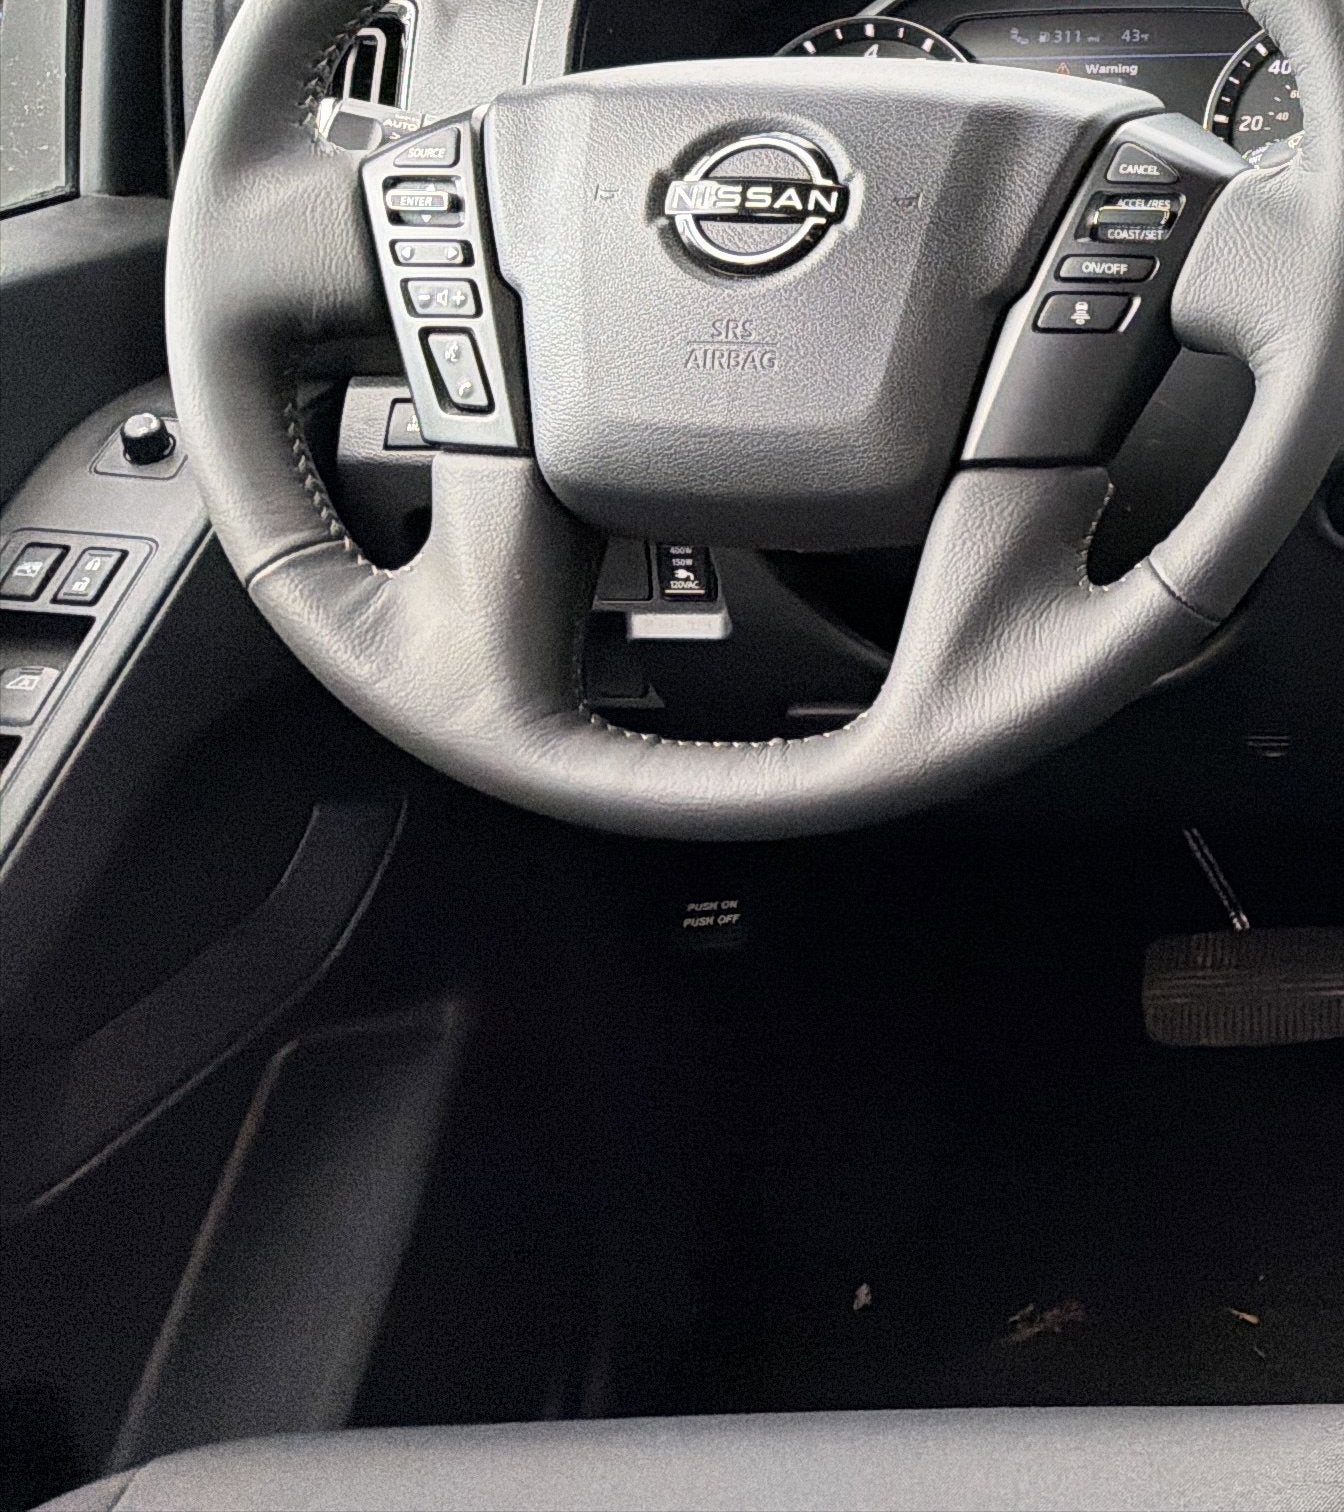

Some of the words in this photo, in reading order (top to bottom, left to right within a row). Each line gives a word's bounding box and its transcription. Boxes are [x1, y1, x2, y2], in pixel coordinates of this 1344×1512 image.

[1054, 29, 1081, 43] 311
[864, 43, 880, 58] 4
[1085, 63, 1138, 76] Warning
[1268, 59, 1292, 75] 40
[383, 118, 419, 131] AUTO
[1239, 115, 1264, 132] 20
[408, 148, 446, 159] SOURCE
[1119, 163, 1160, 176] CANCEL
[400, 196, 433, 207] ENTER
[672, 184, 839, 213] NISSAN
[1117, 198, 1171, 210] ACCEL/RES
[1107, 228, 1165, 241] COAST/SET
[1082, 261, 1128, 275] ON/OFF
[710, 318, 755, 340] SRS
[684, 347, 779, 371] AIRBAG
[686, 901, 720, 912] PUSH
[721, 899, 739, 910] ON
[682, 915, 715, 929] PUSH
[716, 913, 741, 926] OFF
